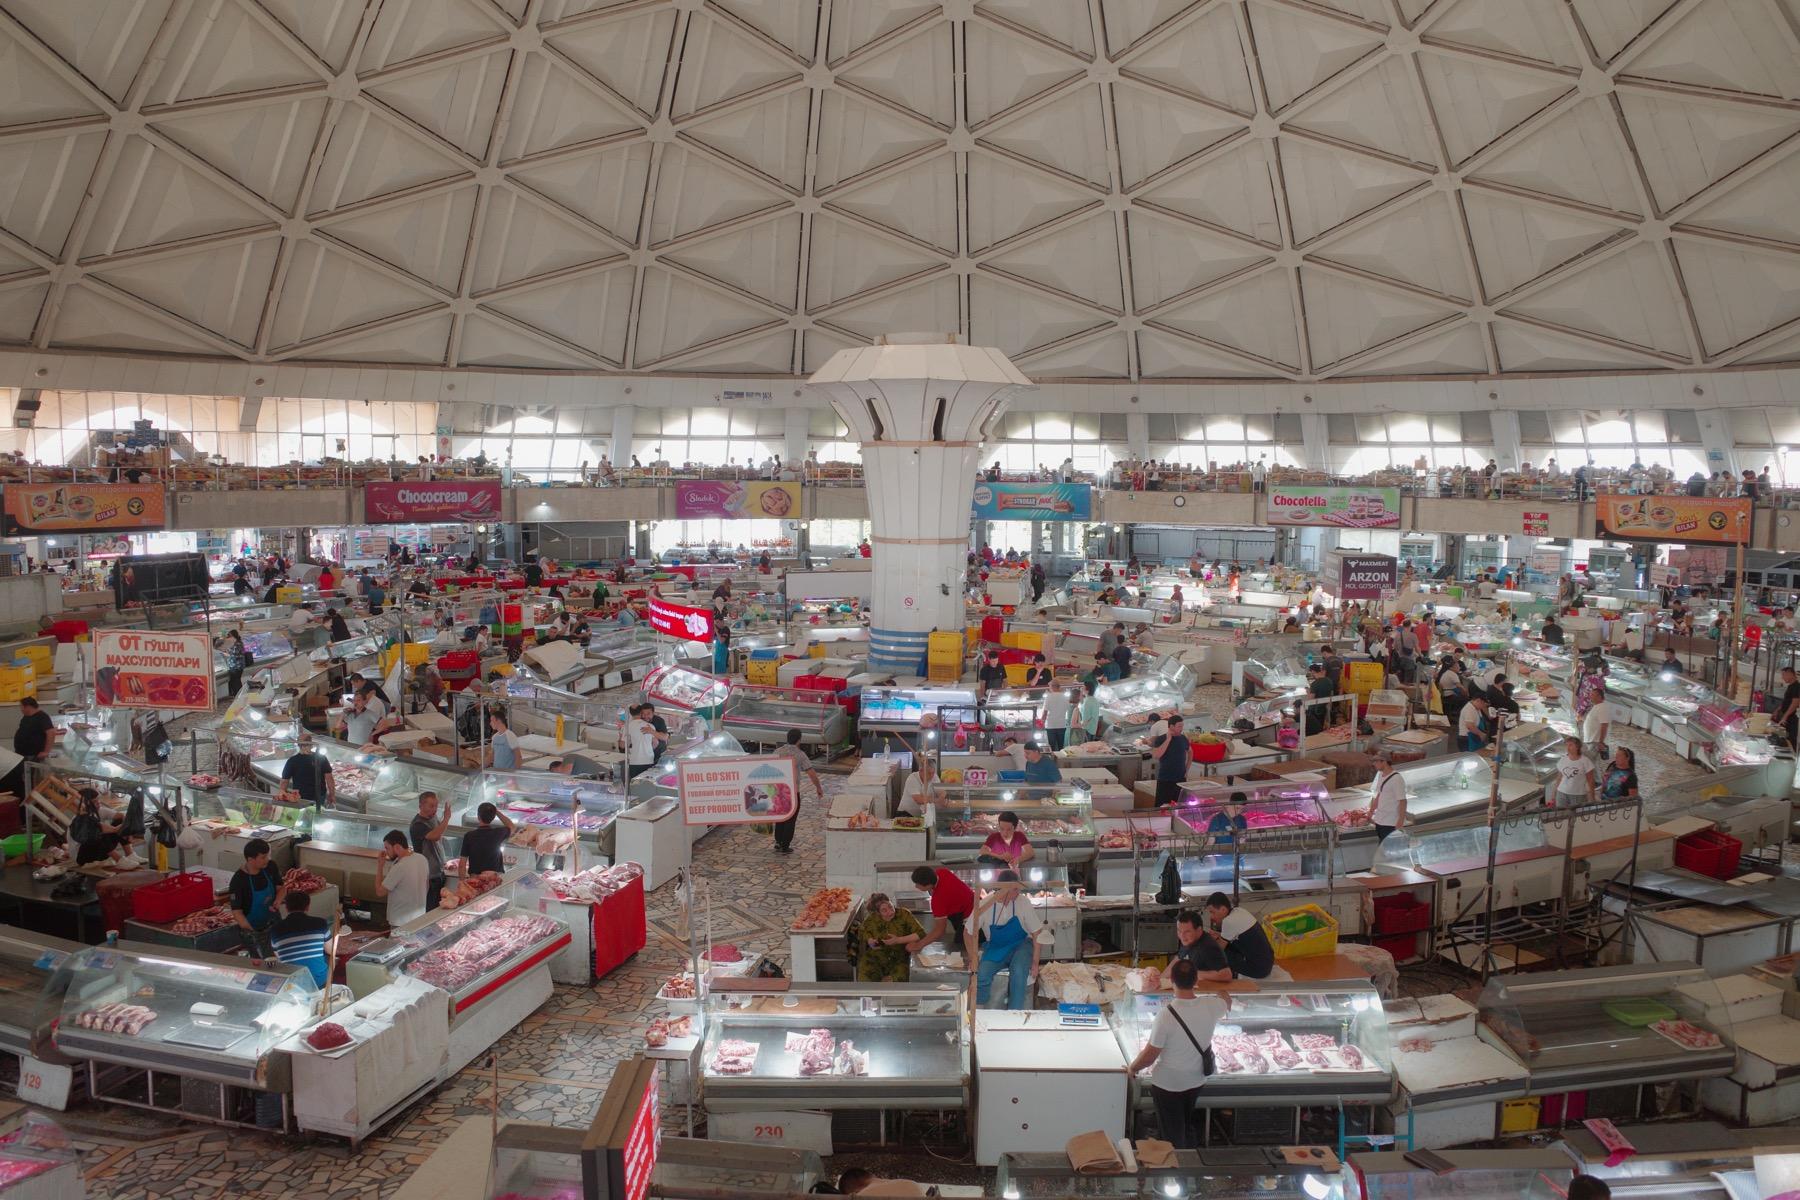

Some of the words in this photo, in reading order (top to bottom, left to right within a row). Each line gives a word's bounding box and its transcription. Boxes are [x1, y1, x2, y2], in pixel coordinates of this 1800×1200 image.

[397, 489, 468, 503] Chococream
[96, 509, 116, 521] BILAN
[1676, 521, 1696, 532] BILAN
[1349, 572, 1389, 582] ARZON
[118, 634, 142, 651] ОТ
[144, 639, 185, 653] ГЎШТИ
[686, 773, 705, 783] MOL
[689, 805, 706, 815] BEEF
[707, 804, 742, 814] PRODUCT
[754, 1126, 783, 1138] 230
